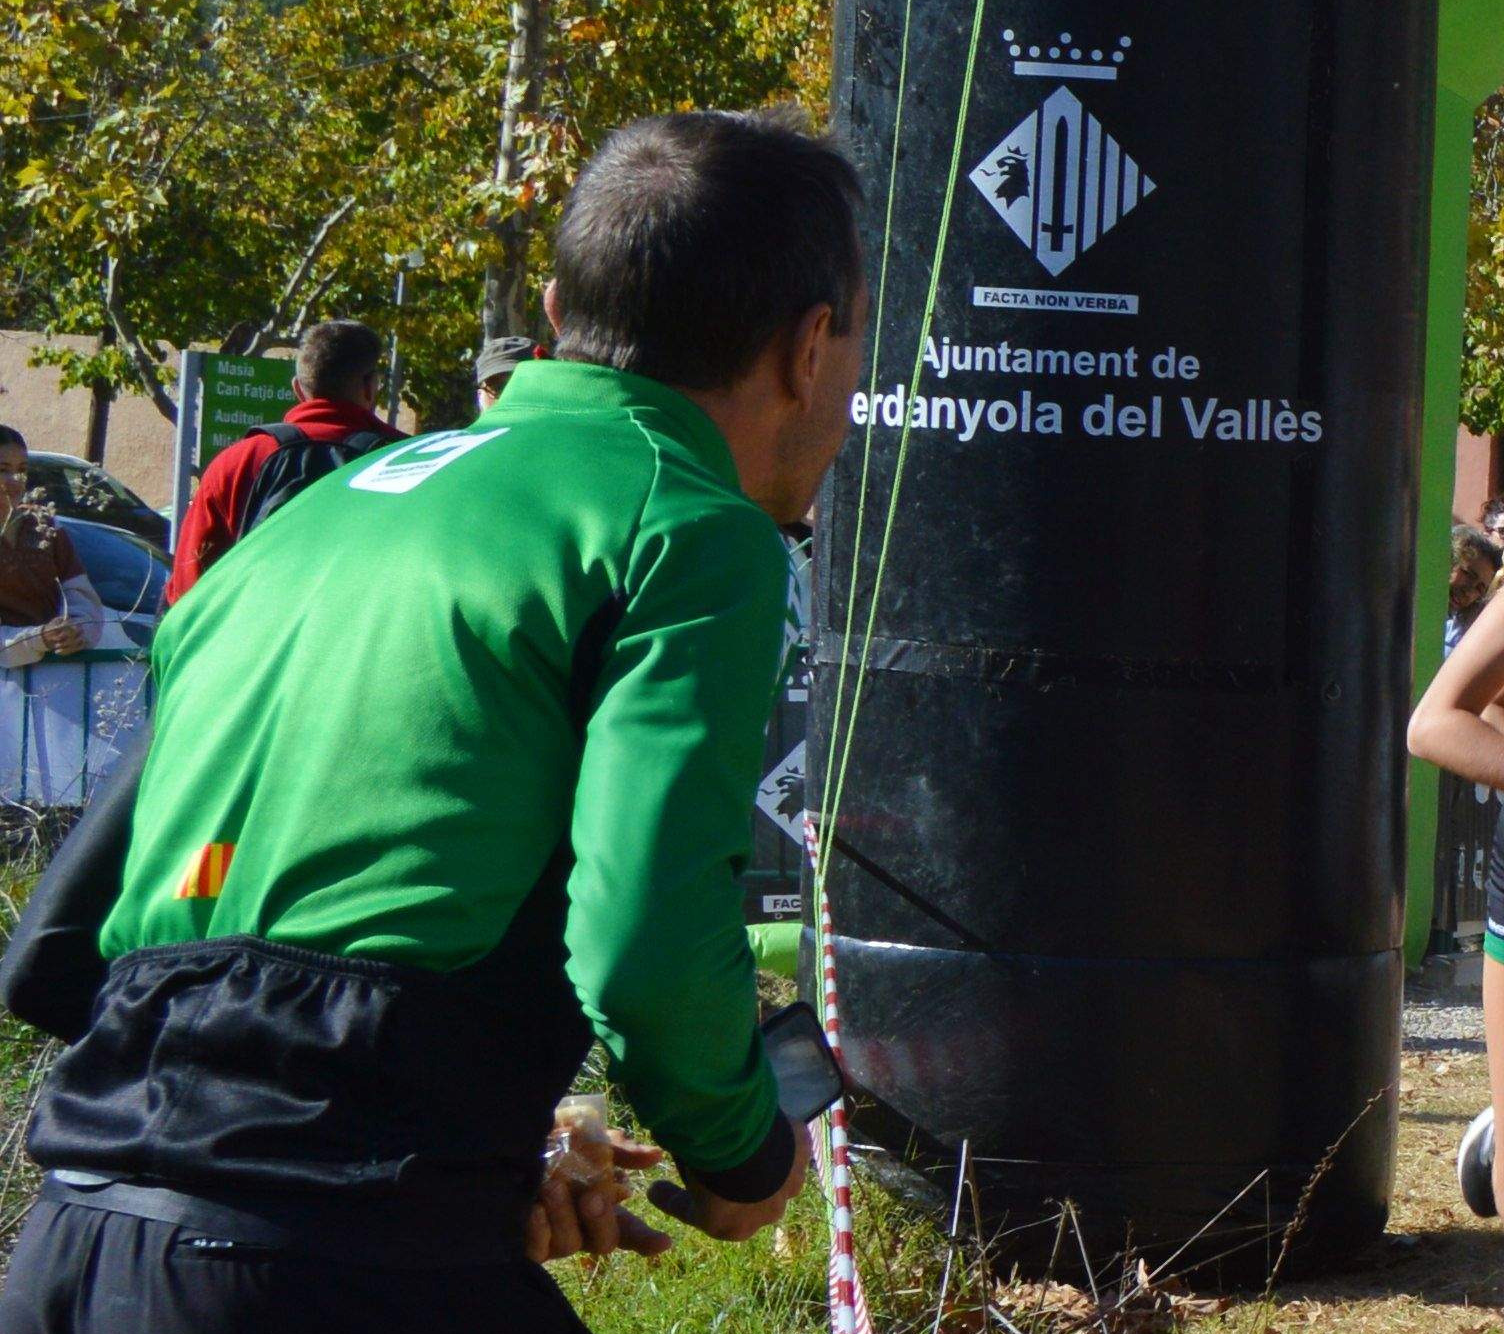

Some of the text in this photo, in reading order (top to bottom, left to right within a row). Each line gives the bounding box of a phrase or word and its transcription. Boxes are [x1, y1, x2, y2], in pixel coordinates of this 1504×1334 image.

[983, 291, 1129, 310] FACTA NON VERBA
[923, 336, 1200, 380] Ajuntament de
[217, 381, 240, 396] Can
[850, 383, 1323, 443] erdanyola del Vallès
[773, 898, 801, 910] FAC
